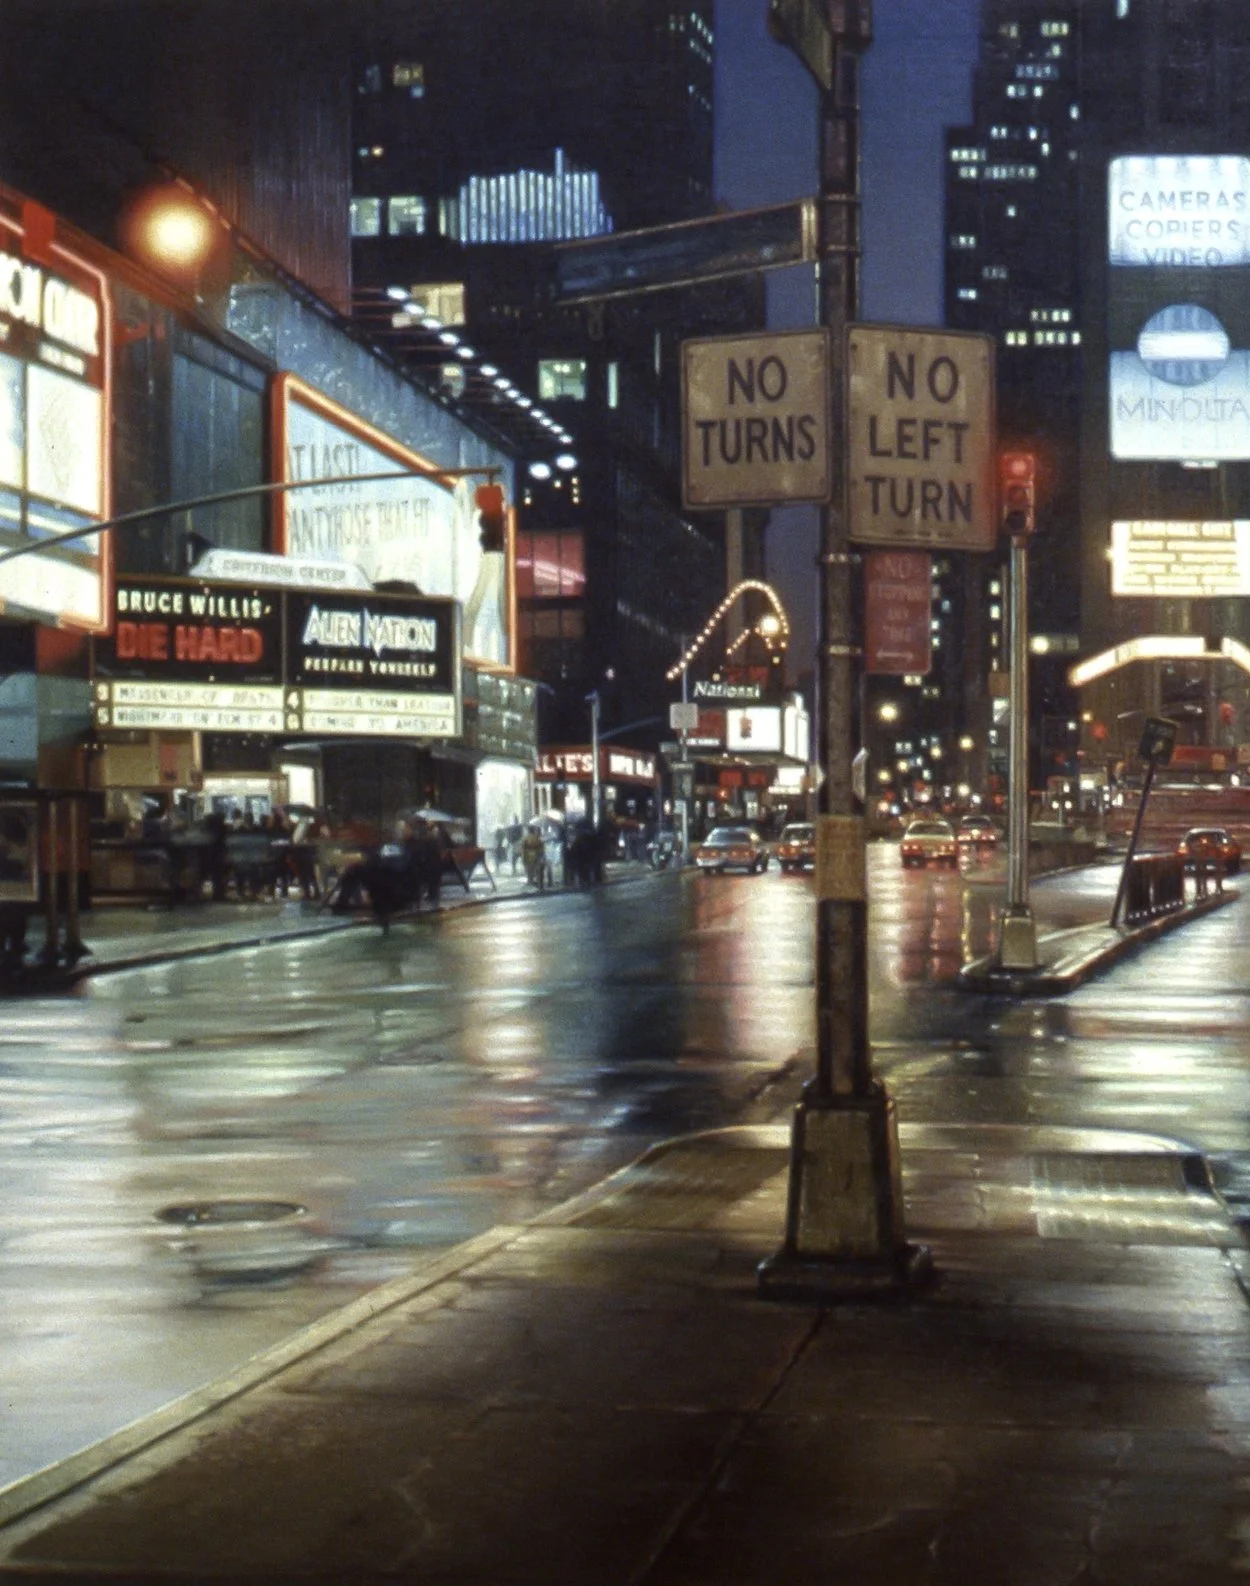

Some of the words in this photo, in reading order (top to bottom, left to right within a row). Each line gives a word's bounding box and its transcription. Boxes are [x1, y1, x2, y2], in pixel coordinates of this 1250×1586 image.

[1119, 191, 1247, 212] CAMERAS
[1126, 219, 1241, 240] COPIERS
[1142, 247, 1223, 266] VIDEO
[728, 354, 788, 405] NO
[887, 351, 960, 403] NO
[696, 413, 817, 467] TURNS
[868, 414, 970, 464] LEFT
[864, 475, 974, 524] TURN
[117, 589, 184, 614] BRUCE
[189, 593, 262, 619] WILLIS
[116, 621, 169, 661] DIE
[175, 623, 264, 664] HARD
[302, 604, 362, 647] ALIEN
[362, 606, 437, 658] NATION
